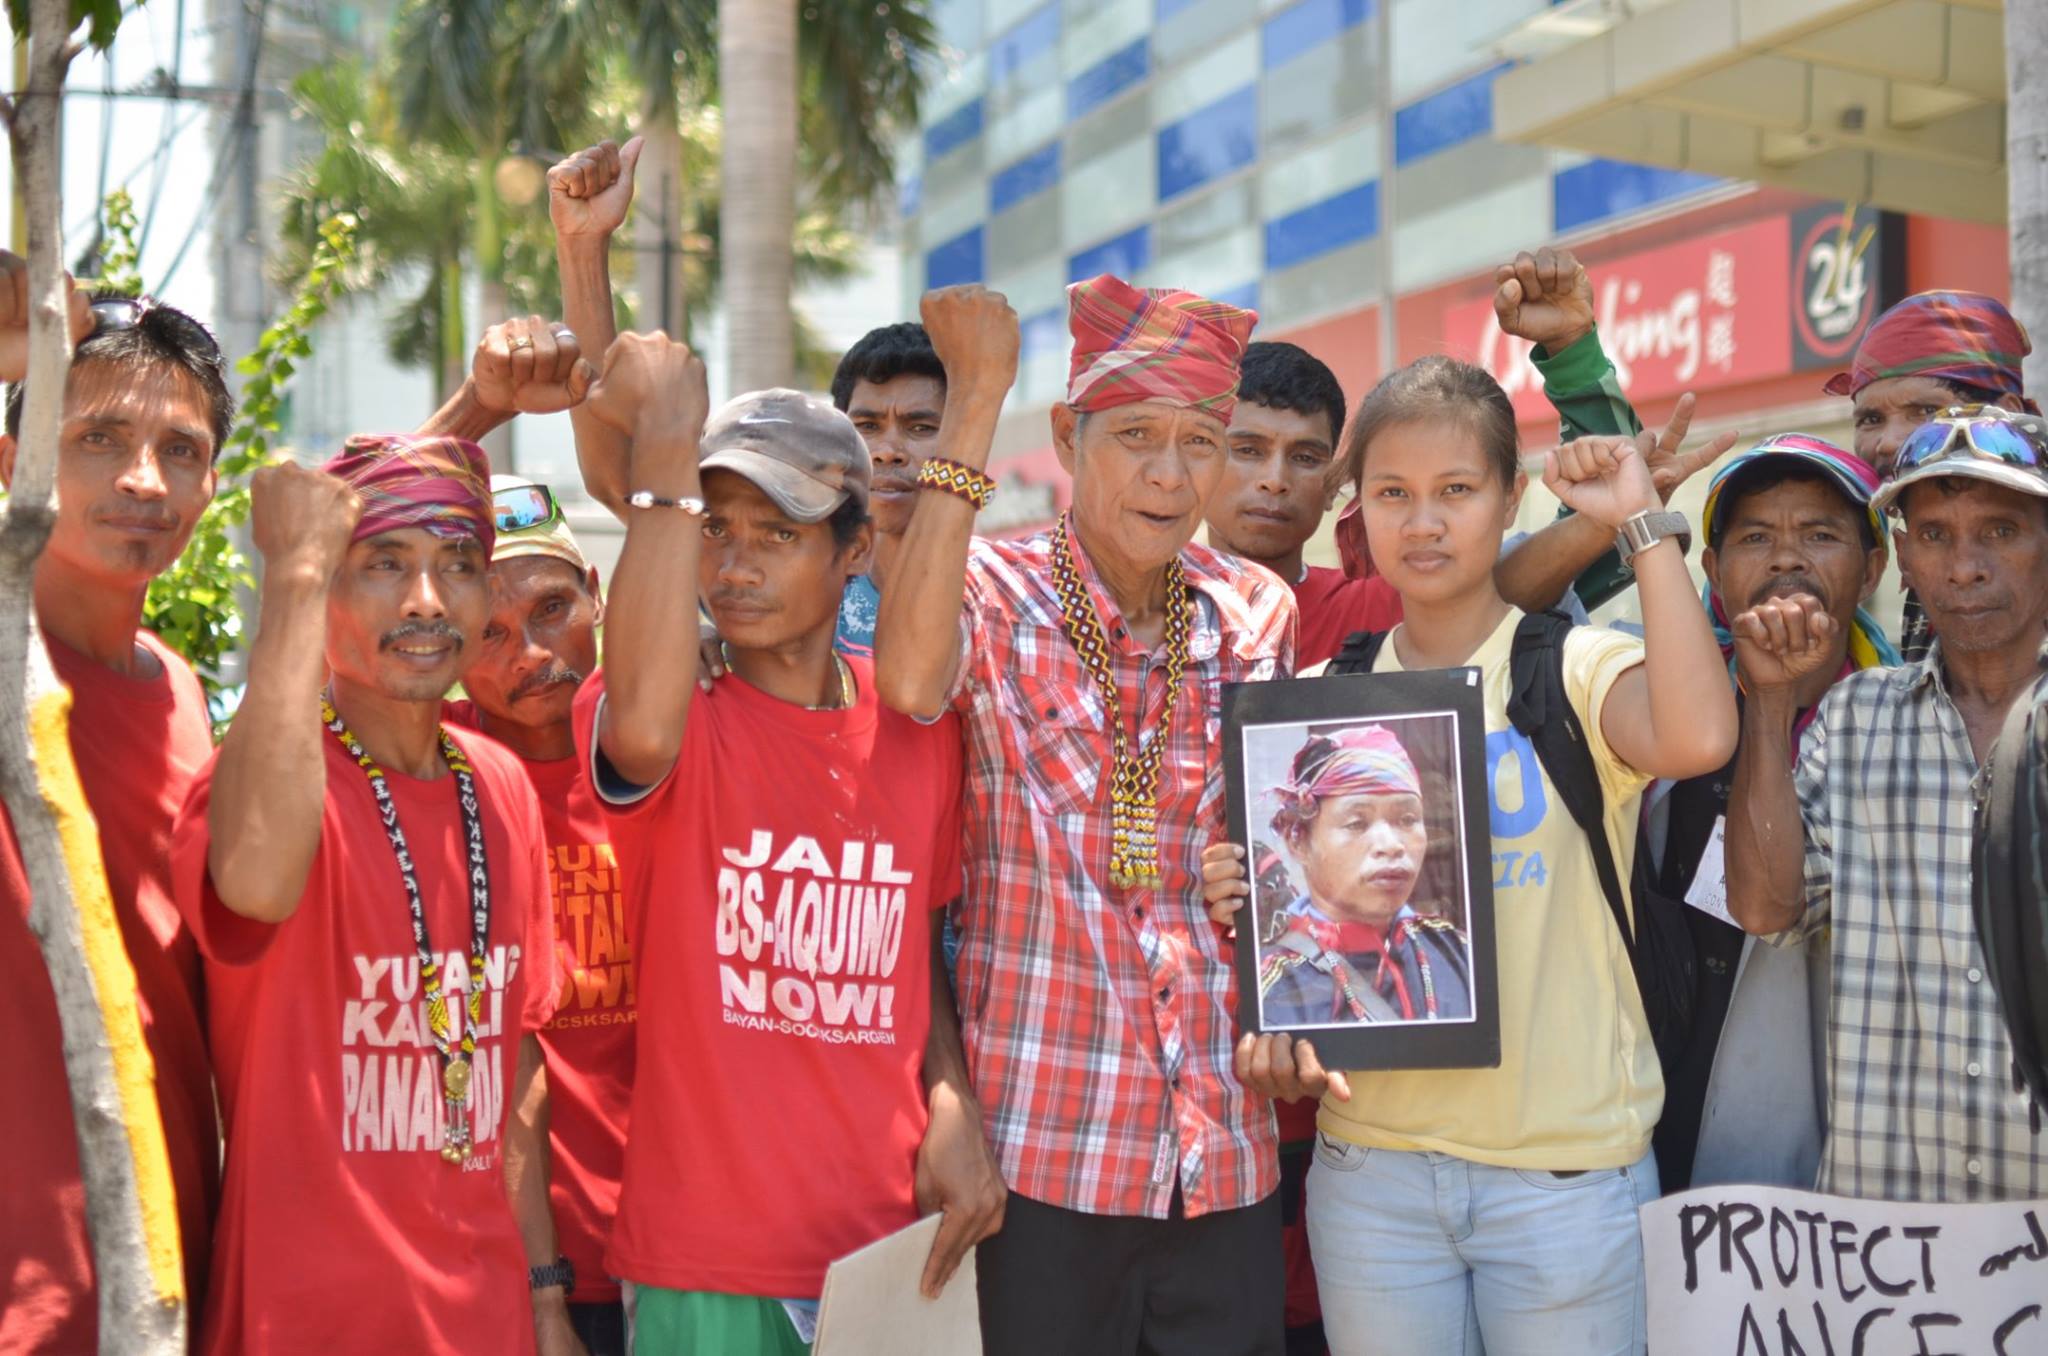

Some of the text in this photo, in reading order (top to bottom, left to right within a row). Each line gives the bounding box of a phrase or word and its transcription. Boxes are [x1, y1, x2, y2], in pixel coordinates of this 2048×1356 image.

[1809, 240, 1867, 321] 24
[722, 829, 913, 884] JAIL
[715, 867, 906, 981] BS-AQUINO
[719, 964, 896, 1030] NOW!
[1679, 1202, 2048, 1301] PROTECT and
